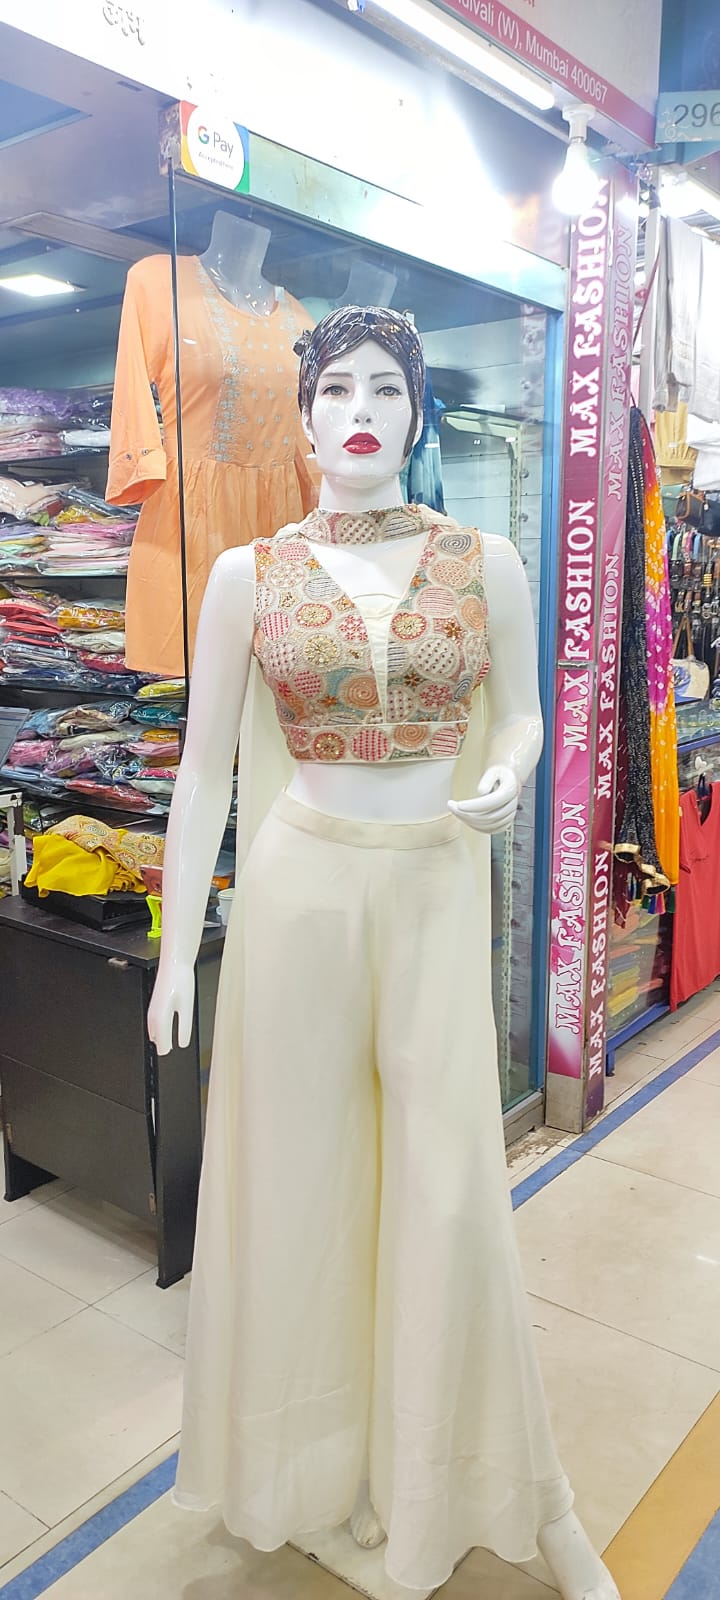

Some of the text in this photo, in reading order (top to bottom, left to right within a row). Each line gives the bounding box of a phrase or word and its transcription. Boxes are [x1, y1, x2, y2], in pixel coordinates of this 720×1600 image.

[213, 131, 234, 159] Pay
[458, 0, 608, 105] ivali (W), Mumbai 400067
[570, 366, 600, 458] MAX
[608, 225, 633, 501] MAX FASHION
[563, 499, 596, 752] MAX FASHION
[597, 553, 620, 800] MAX FASHION
[555, 801, 586, 1034] MAX FASHION
[589, 850, 609, 1081] MAX FASHION
